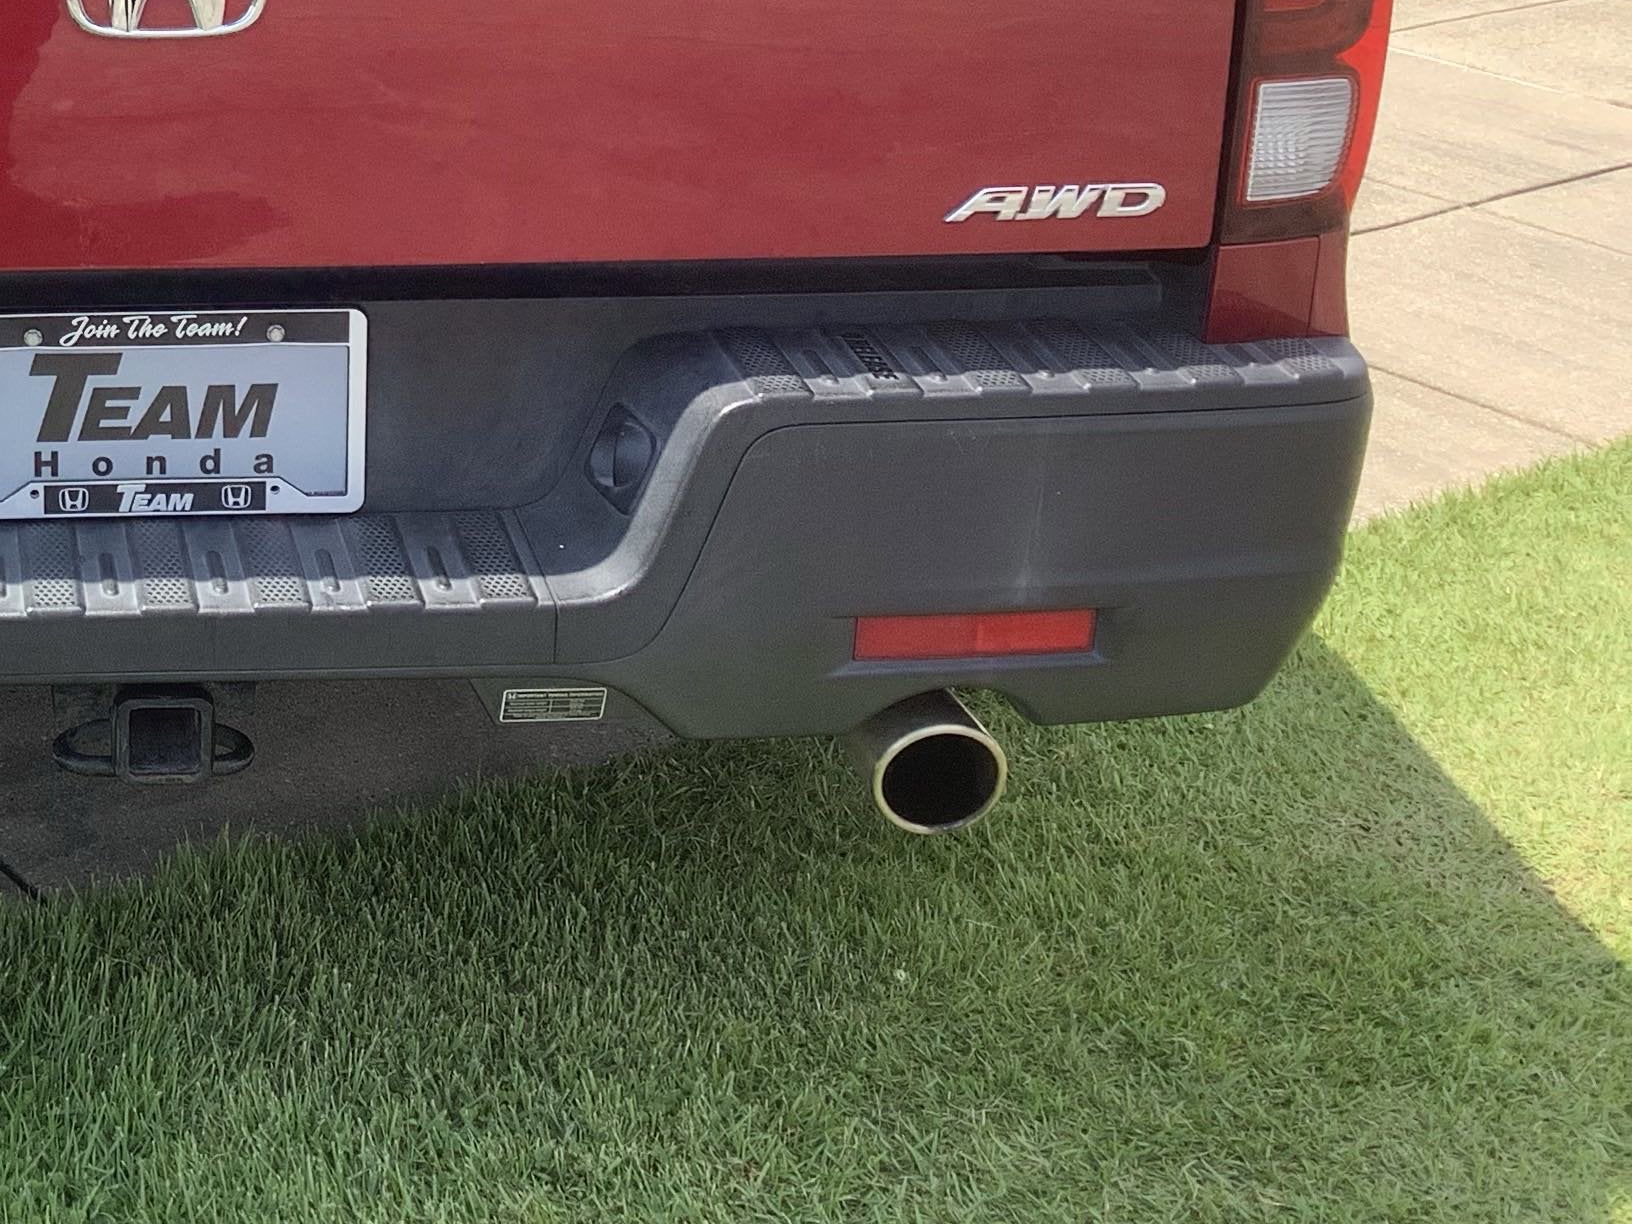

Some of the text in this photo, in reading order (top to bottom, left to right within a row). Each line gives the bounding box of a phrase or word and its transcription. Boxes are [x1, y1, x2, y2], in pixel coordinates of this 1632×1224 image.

[943, 182, 1168, 223] AWD
[59, 314, 248, 346] Join The Team!
[28, 352, 279, 443] TEAM
[114, 483, 195, 512] TEAM
